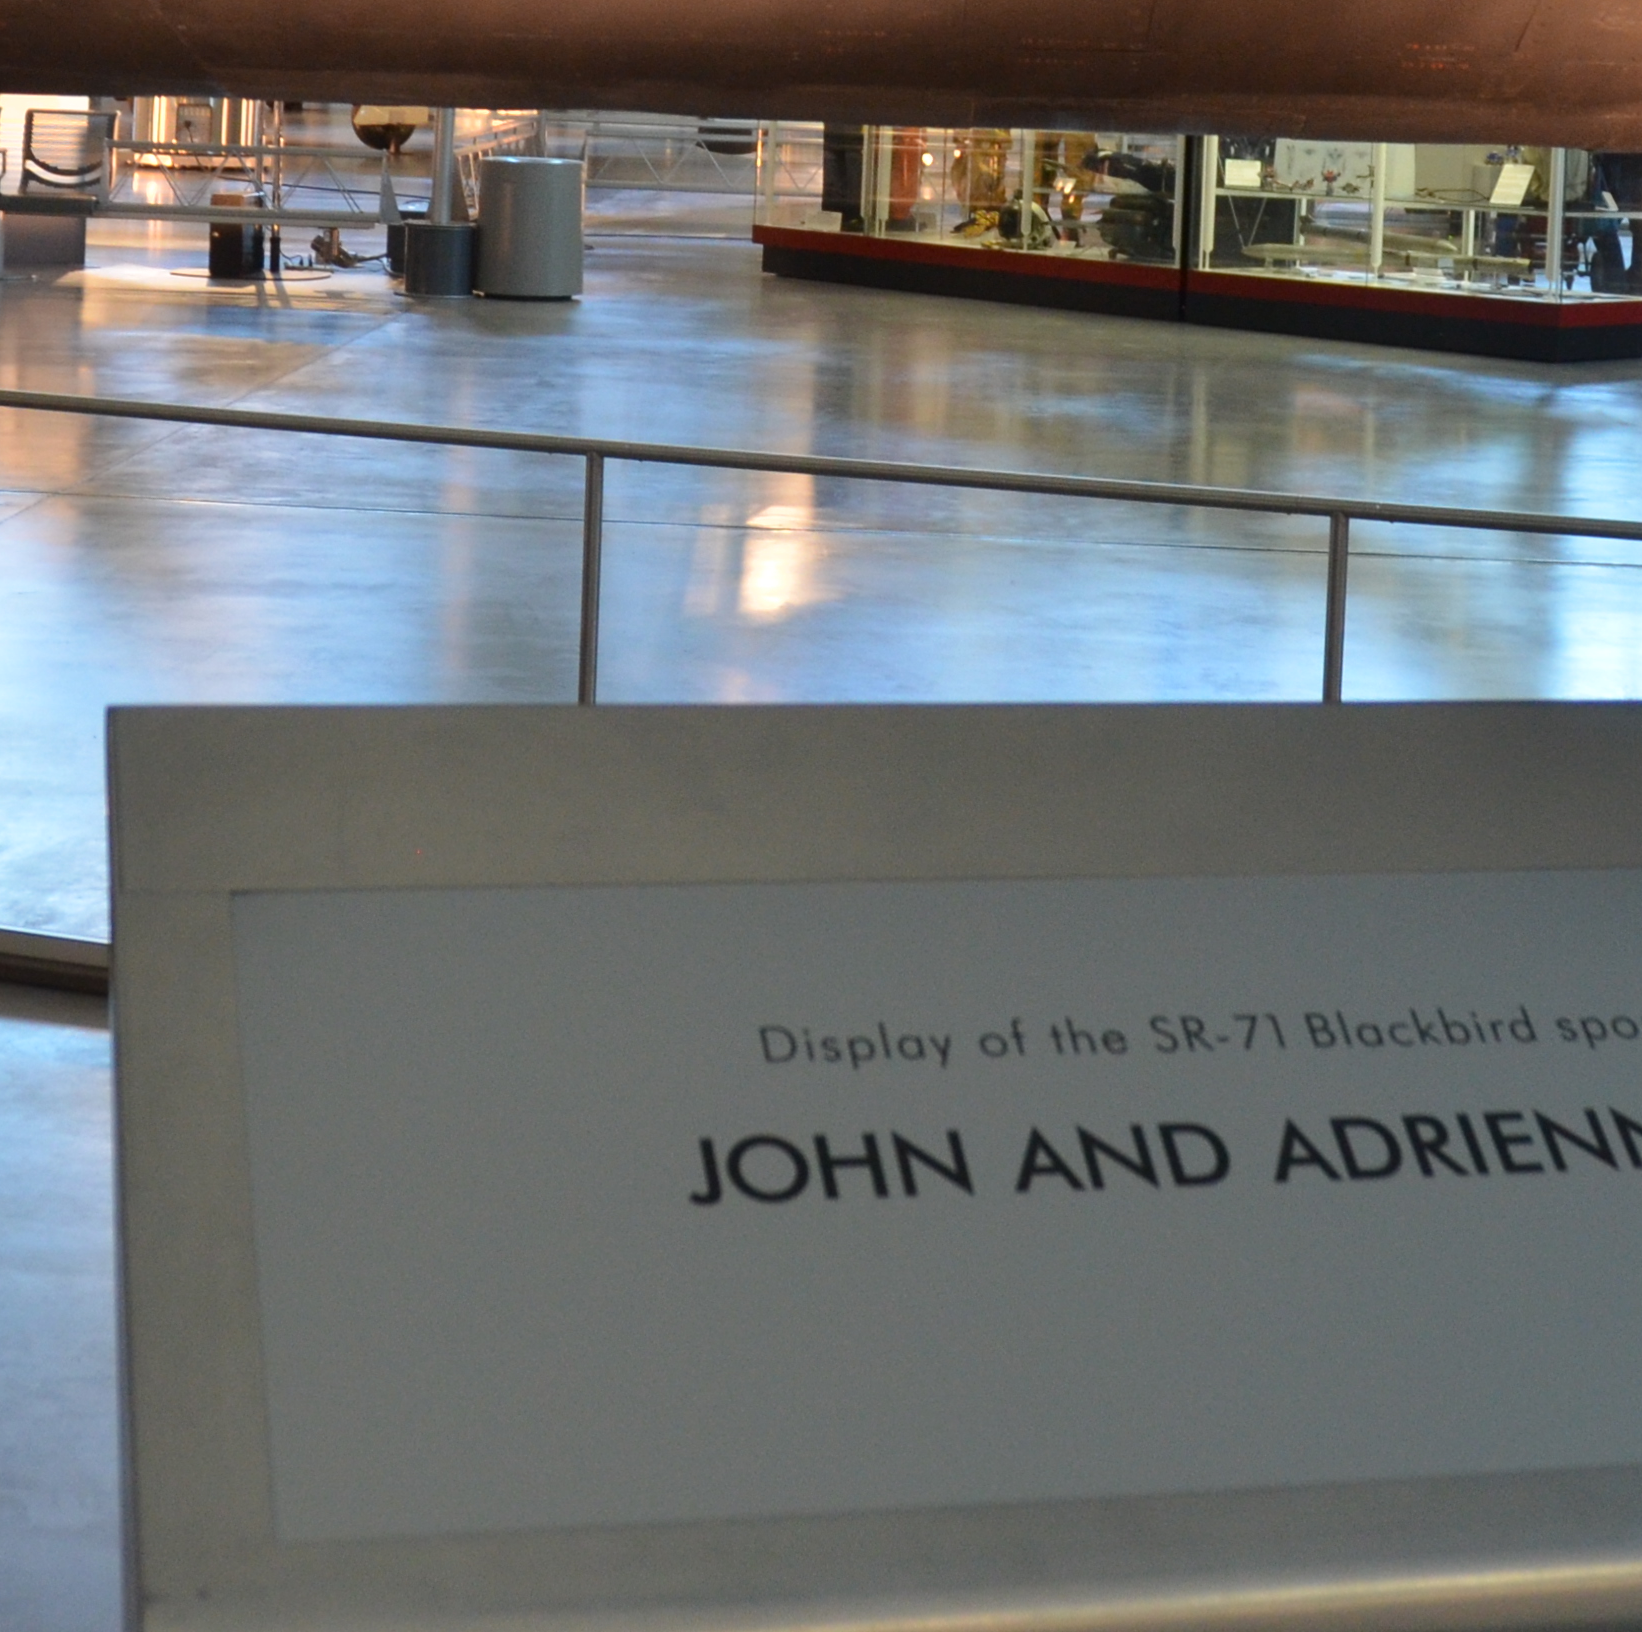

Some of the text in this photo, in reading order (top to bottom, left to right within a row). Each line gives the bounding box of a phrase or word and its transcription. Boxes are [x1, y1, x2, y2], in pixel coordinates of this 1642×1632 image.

[758, 1020, 954, 1070] Display
[978, 1016, 1025, 1059] of
[1050, 1016, 1129, 1057] the
[1149, 1012, 1288, 1055] SR-71
[1304, 1005, 1538, 1049] Blackbird
[689, 1128, 975, 1206] JOHN
[1014, 1120, 1231, 1193] AND
